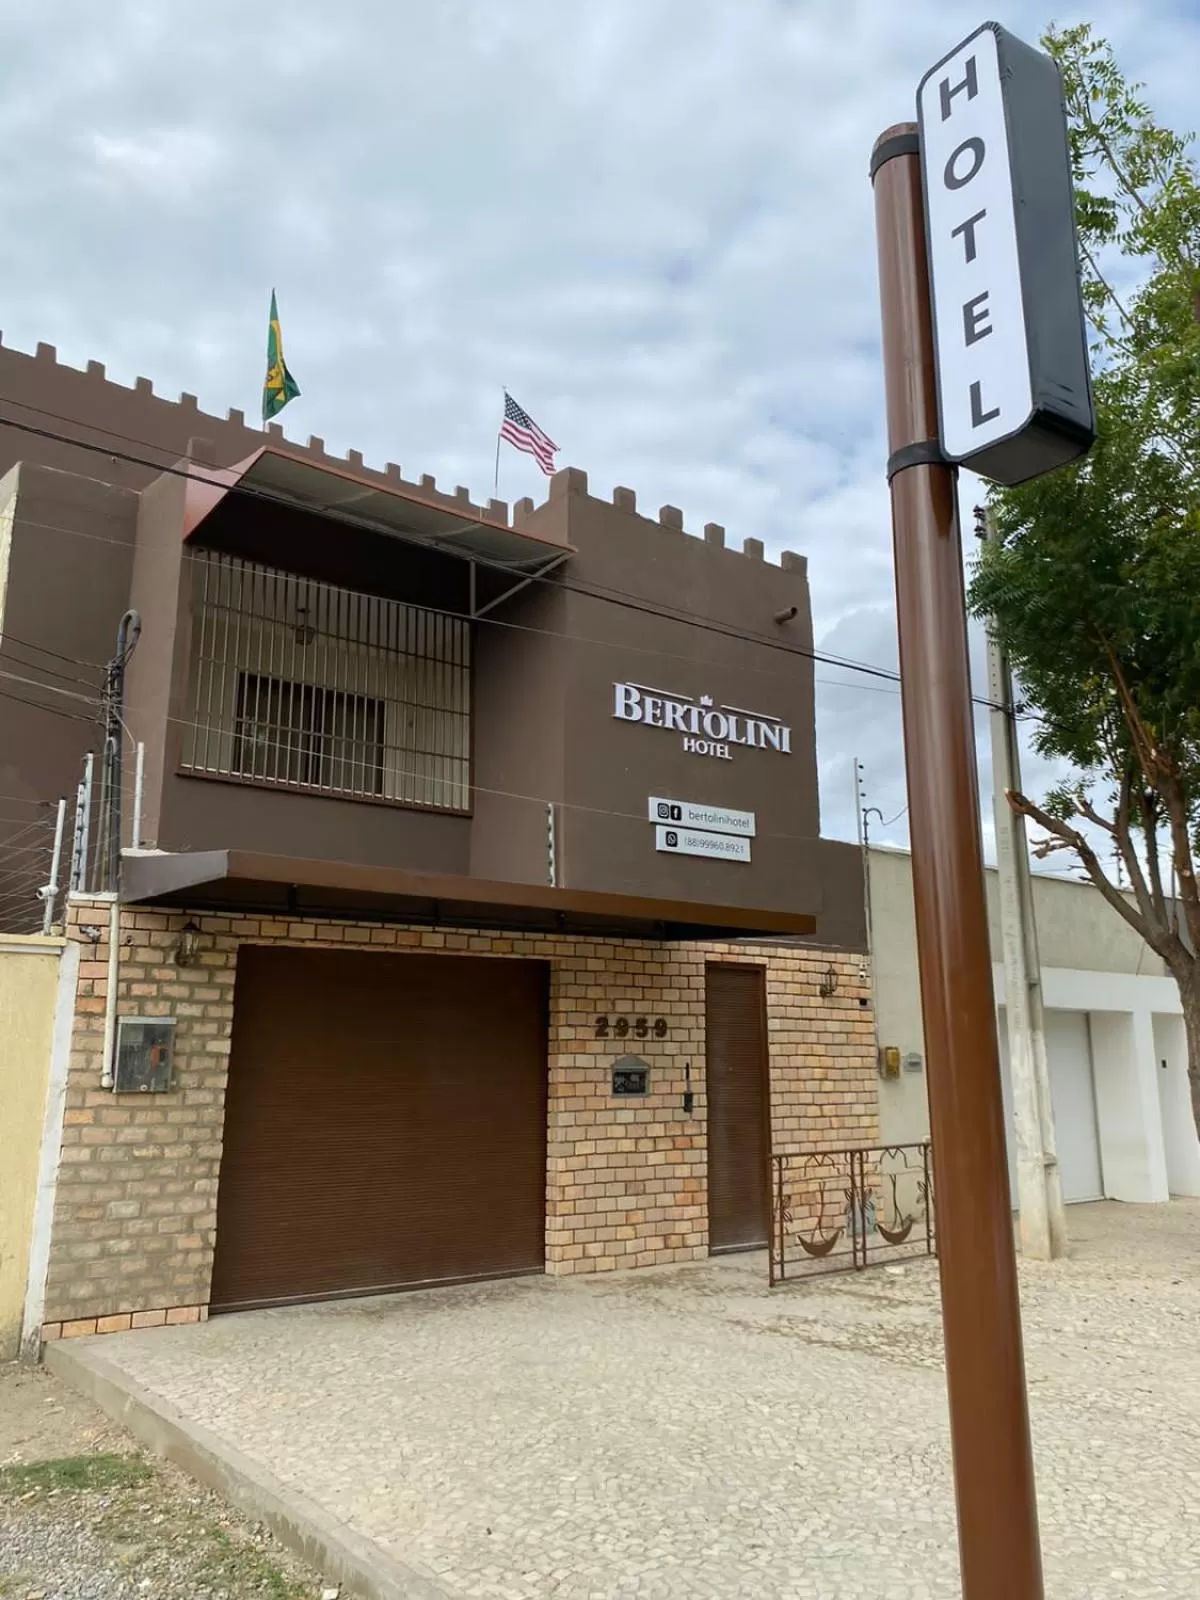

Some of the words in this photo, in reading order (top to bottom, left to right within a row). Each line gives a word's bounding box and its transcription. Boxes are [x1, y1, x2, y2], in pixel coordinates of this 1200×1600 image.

[939, 55, 1000, 429] HOTEL
[612, 682, 792, 754] BERTOLINI
[683, 737, 733, 760] HOTEL
[688, 809, 750, 829] bertolinihotel
[595, 1016, 667, 1038] 2959
